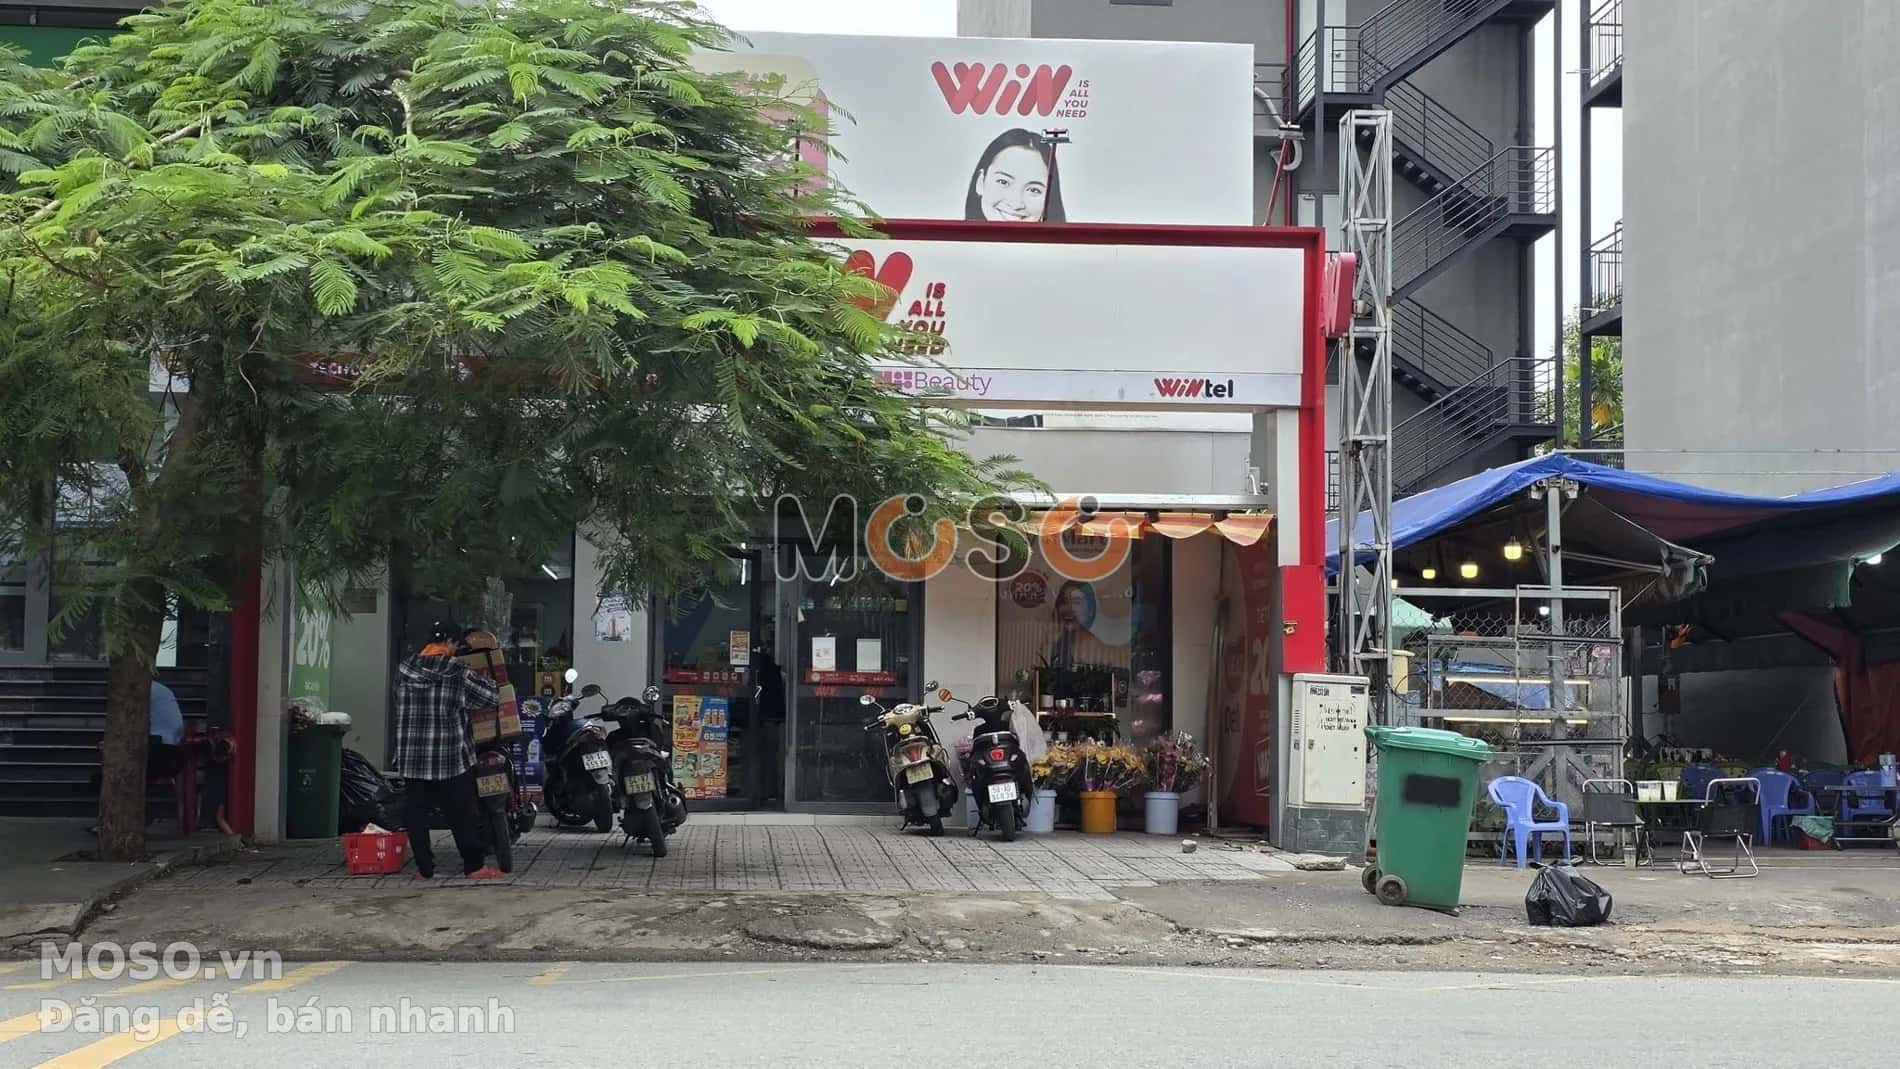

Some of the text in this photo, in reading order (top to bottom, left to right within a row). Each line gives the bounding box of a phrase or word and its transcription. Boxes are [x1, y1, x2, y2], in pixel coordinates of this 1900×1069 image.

[1079, 79, 1090, 88] IS
[1069, 89, 1089, 98] ALL
[1064, 99, 1088, 109] YOU
[1055, 109, 1087, 118] NEED
[926, 282, 946, 299] IS
[908, 299, 946, 318] ALL
[914, 371, 992, 396] Beauty
